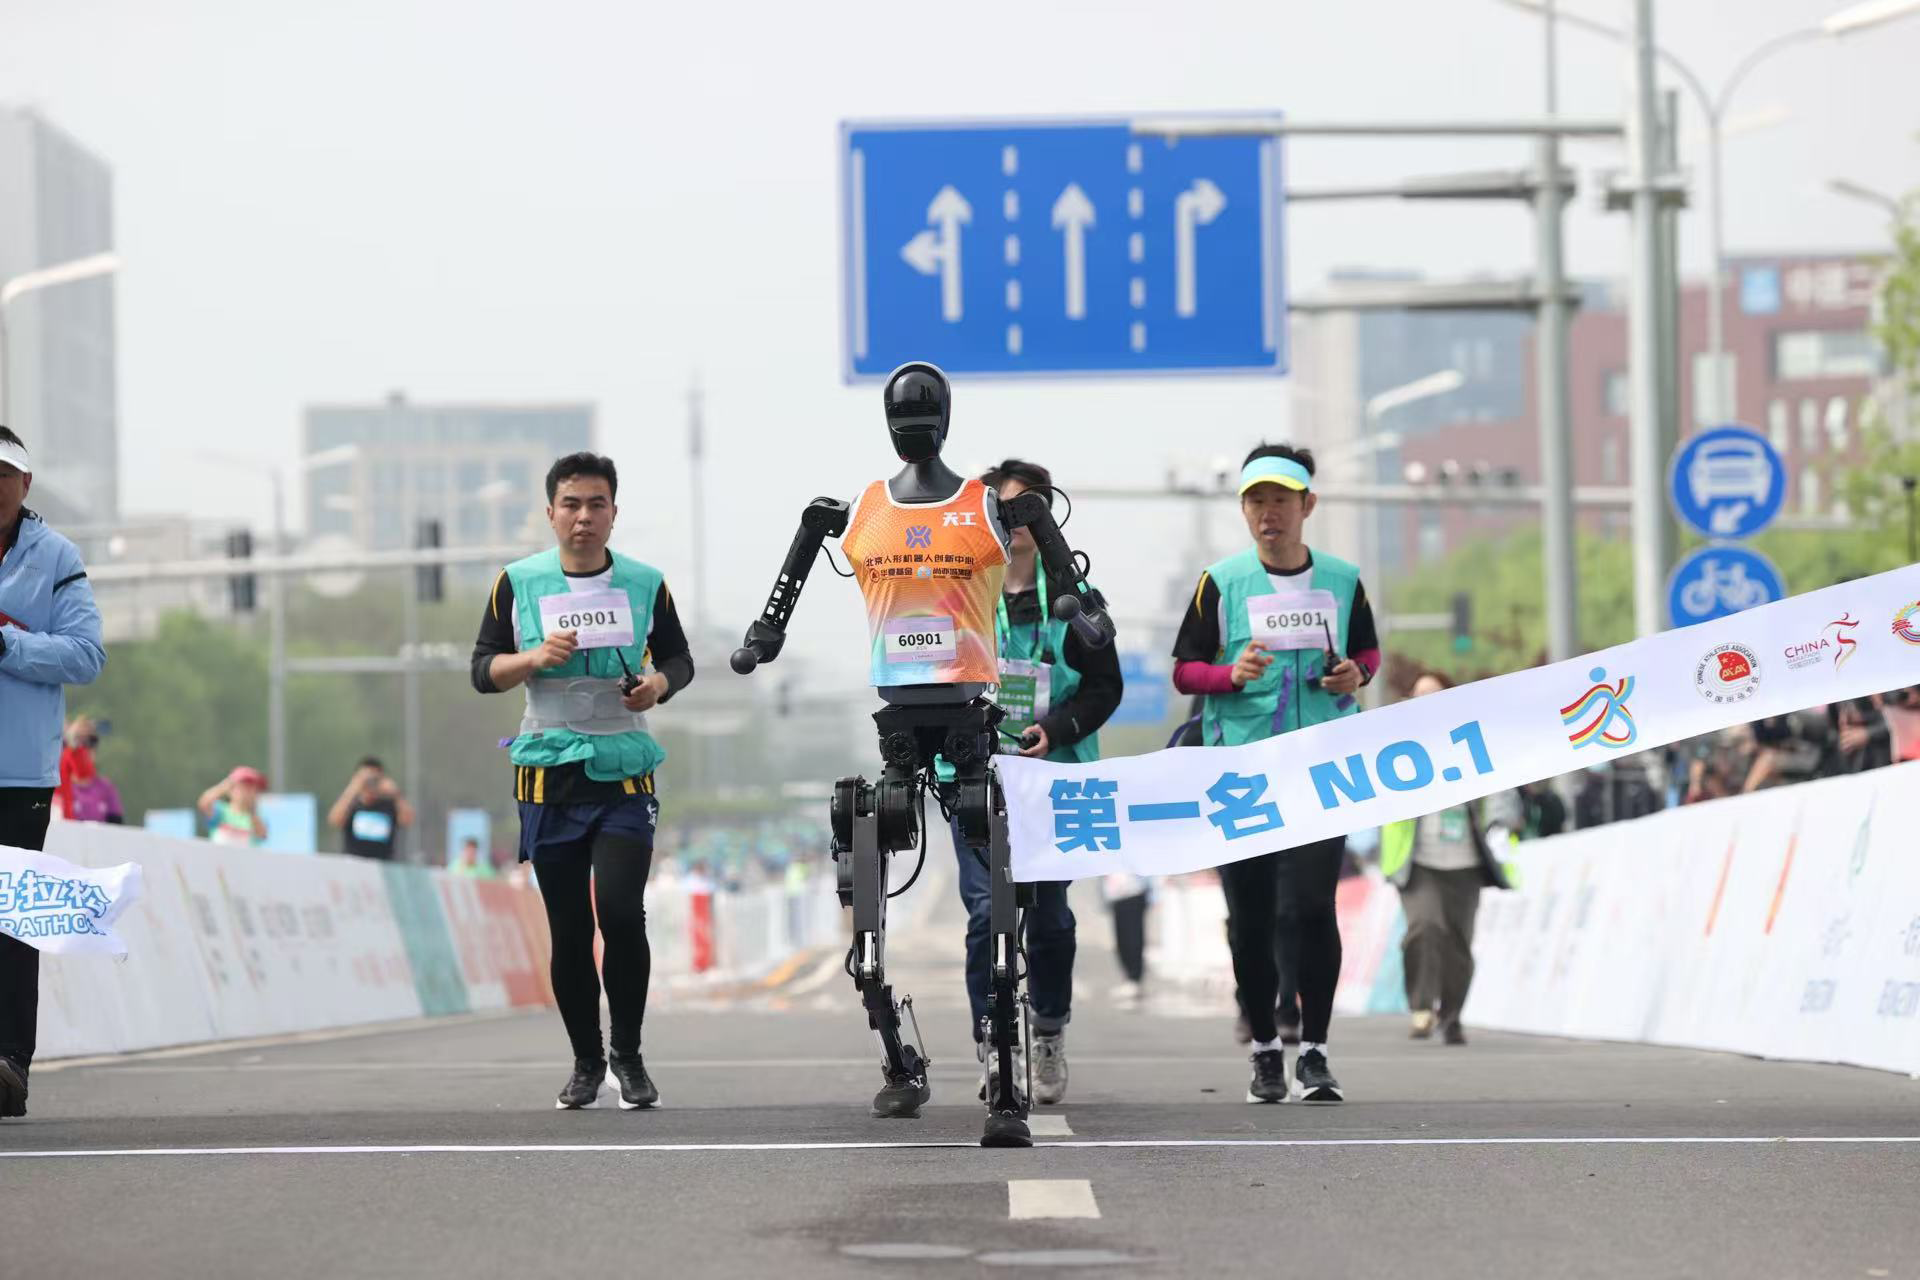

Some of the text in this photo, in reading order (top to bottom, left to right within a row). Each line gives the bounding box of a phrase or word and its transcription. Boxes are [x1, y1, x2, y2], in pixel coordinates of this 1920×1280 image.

[942, 511, 977, 527] 天工
[865, 554, 975, 567] 北京人形机器人创新中心
[880, 567, 913, 578] 华夏基金
[558, 610, 617, 629] 60901
[1266, 611, 1323, 629] 60901
[898, 633, 943, 647] 60901
[1784, 638, 1830, 658] CHINA
[1697, 644, 1758, 685] CHINESE ATHLETICS ASSOCIATION
[1049, 719, 1495, 853] 第一名 NO.1
